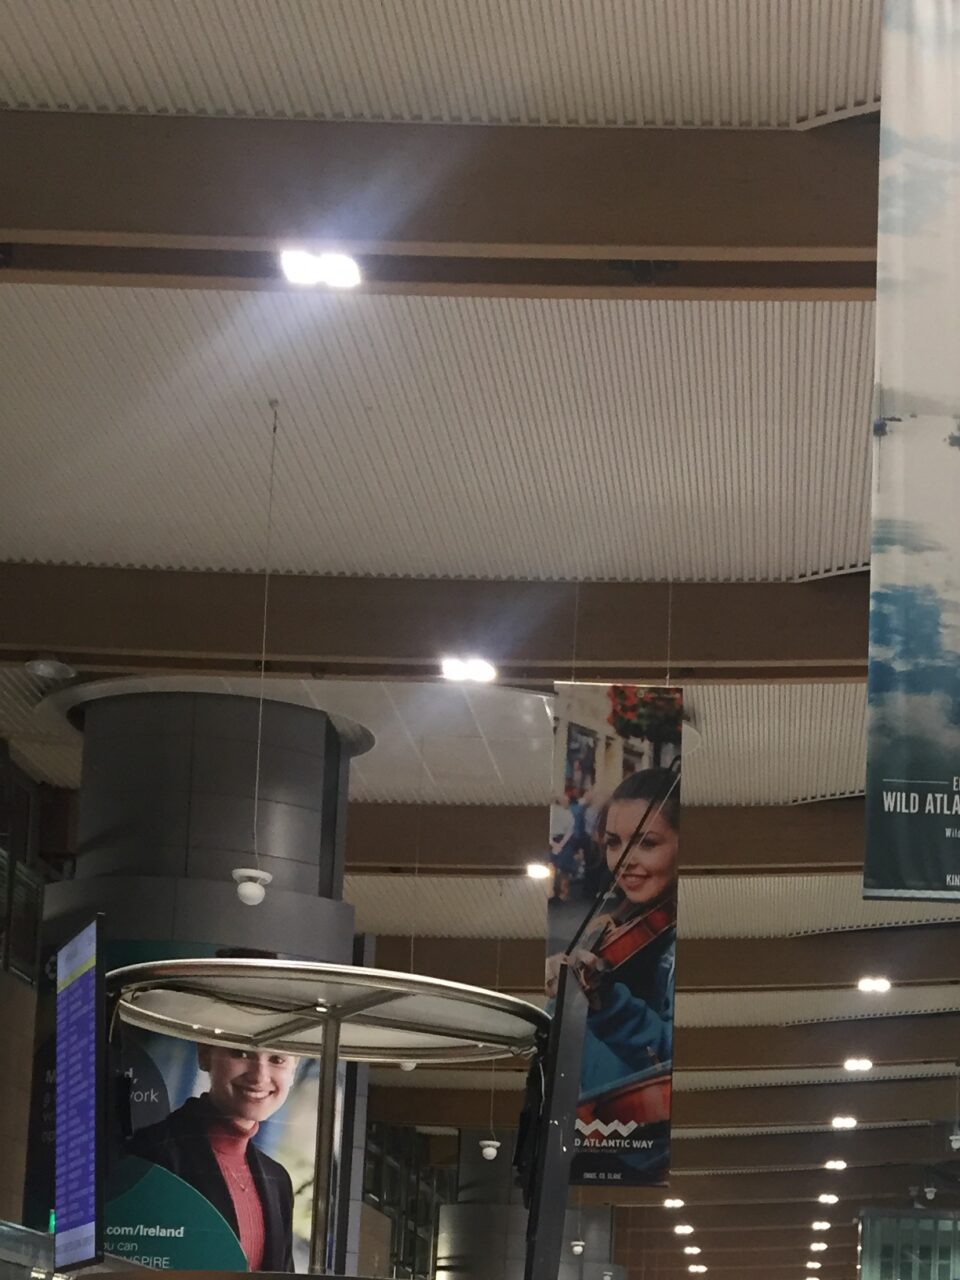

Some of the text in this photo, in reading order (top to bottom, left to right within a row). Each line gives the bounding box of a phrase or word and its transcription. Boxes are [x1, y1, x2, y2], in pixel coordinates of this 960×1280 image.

[882, 791, 919, 813] WILD
[583, 1138, 630, 1148] ATLANTIC
[632, 1140, 654, 1149] WAY
[117, 1242, 138, 1251] can
